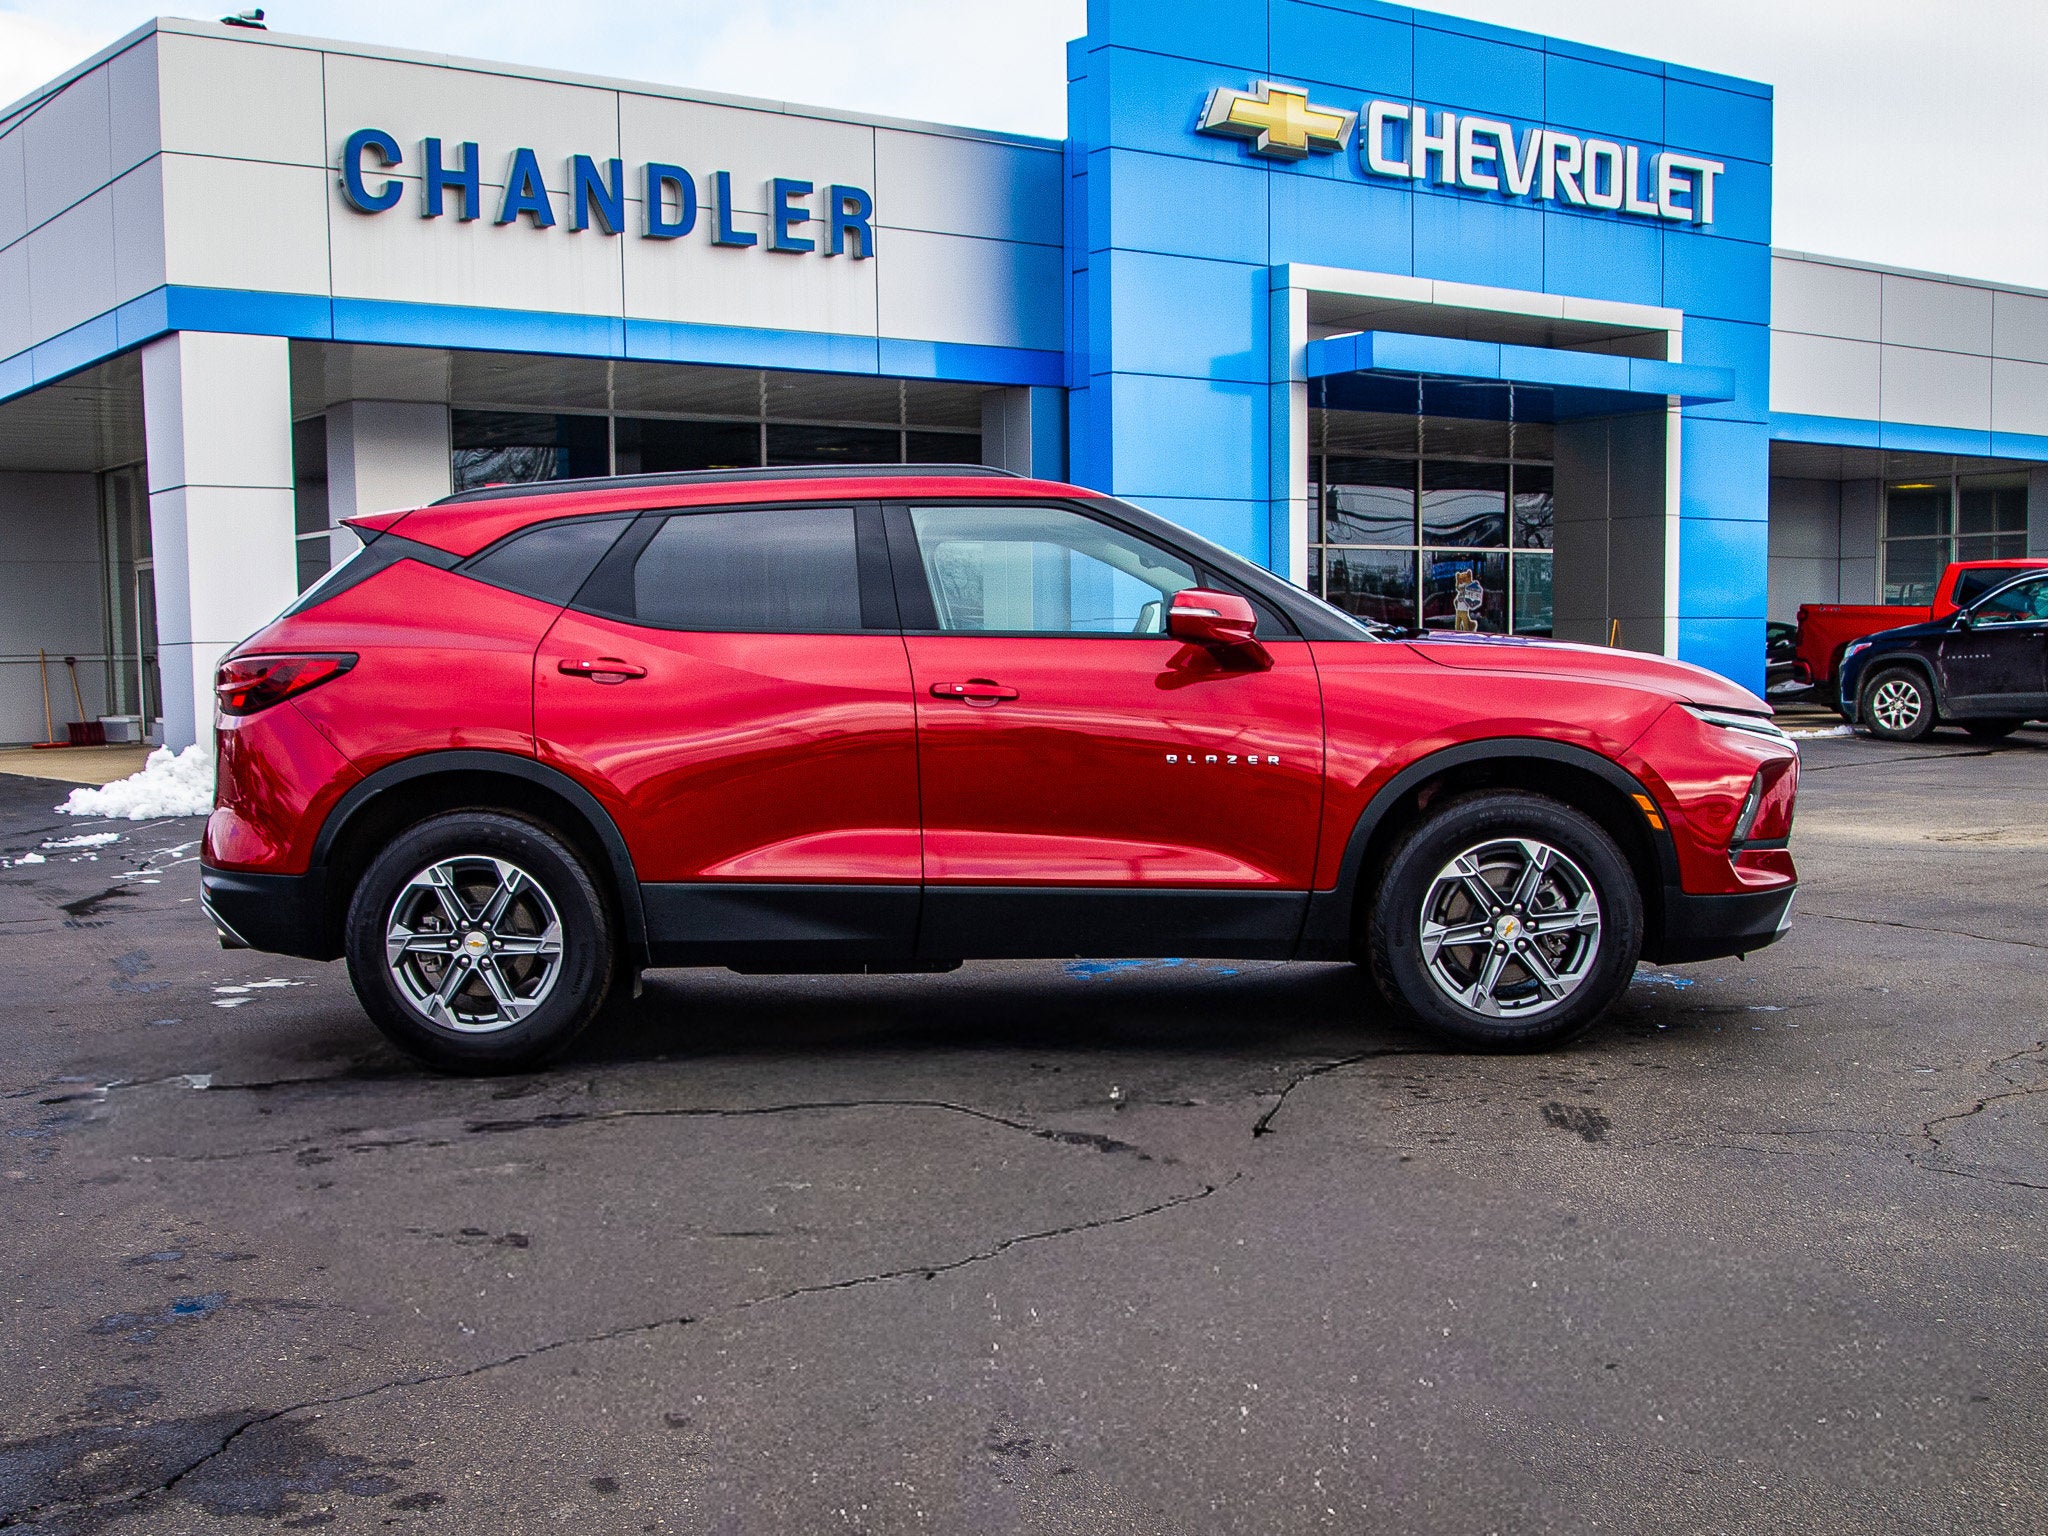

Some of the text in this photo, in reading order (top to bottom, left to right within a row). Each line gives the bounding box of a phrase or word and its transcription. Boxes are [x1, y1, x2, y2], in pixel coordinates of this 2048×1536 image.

[339, 127, 875, 260] CHANDLER
[1360, 100, 1725, 228] CHEVROLET
[1165, 753, 1281, 766] BLAZER
